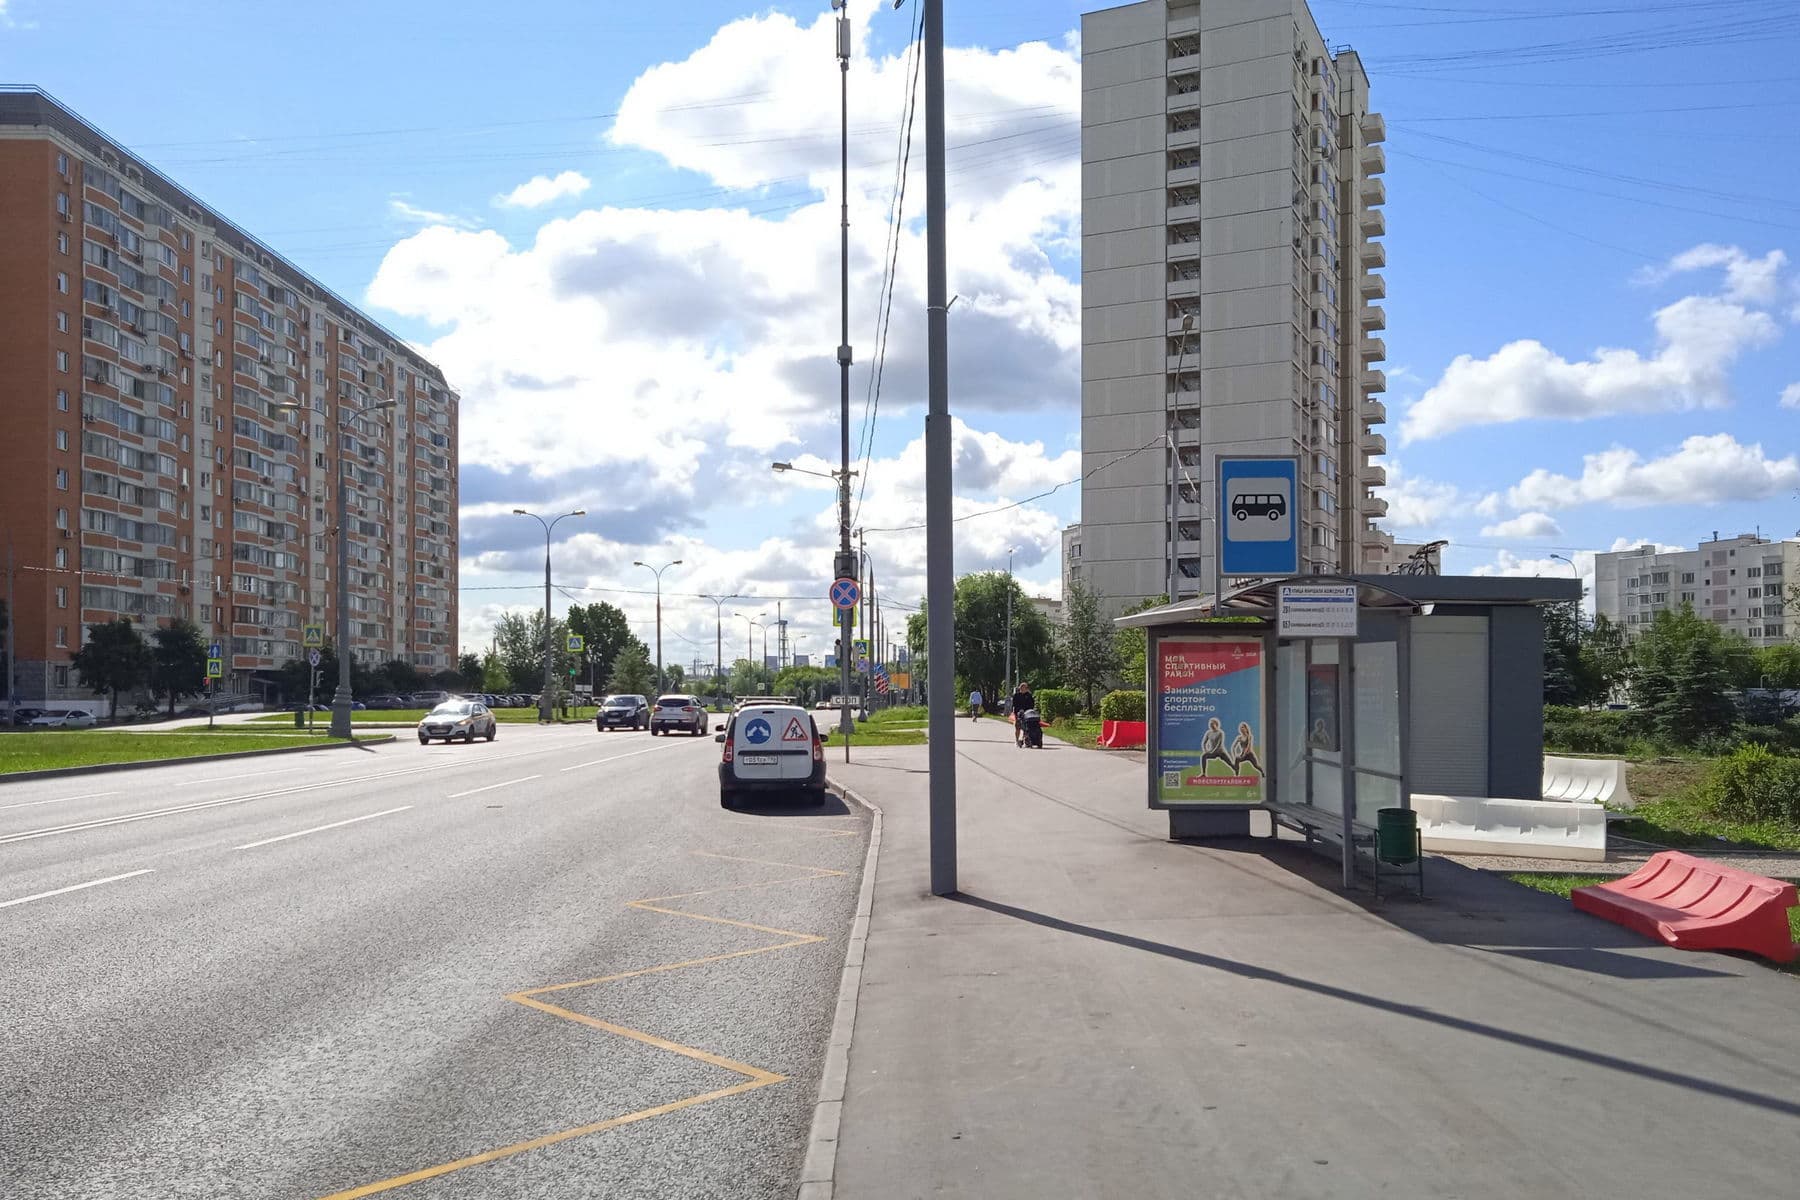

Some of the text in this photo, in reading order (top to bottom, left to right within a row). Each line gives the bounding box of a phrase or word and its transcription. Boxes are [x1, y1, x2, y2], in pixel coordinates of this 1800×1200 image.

[1165, 654, 1185, 662] МОЙ
[1165, 670, 1195, 678] РАЙОН
[1164, 685, 1228, 695] Занимайтесь
[1164, 696, 1206, 704] спортом
[1164, 703, 1216, 712] бесплатно
